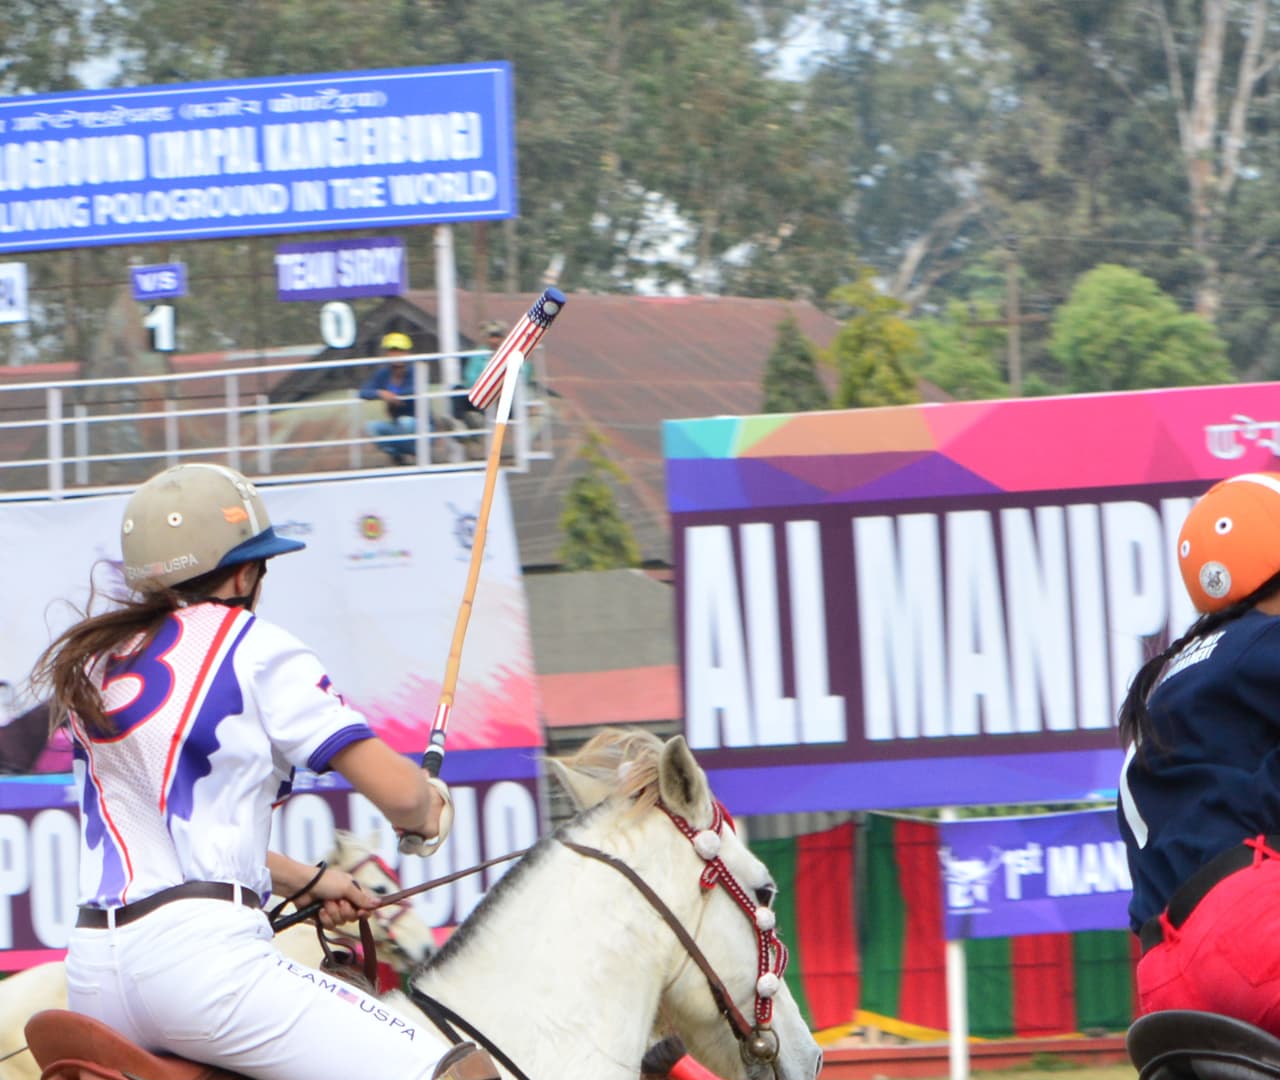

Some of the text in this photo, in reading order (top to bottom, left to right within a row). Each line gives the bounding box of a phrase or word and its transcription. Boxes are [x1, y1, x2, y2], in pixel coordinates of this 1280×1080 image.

[93, 183, 289, 225] POLOGROUND
[291, 180, 328, 212] IN
[328, 176, 387, 209] THE
[388, 169, 497, 206] WORLD
[143, 305, 175, 350] 1
[321, 302, 356, 348] 0
[164, 553, 199, 573] USPA
[683, 520, 847, 748] ALL
[853, 496, 1201, 742] MANIP
[1003, 842, 1043, 899] 1st
[276, 954, 416, 1041] TEAM USPA
